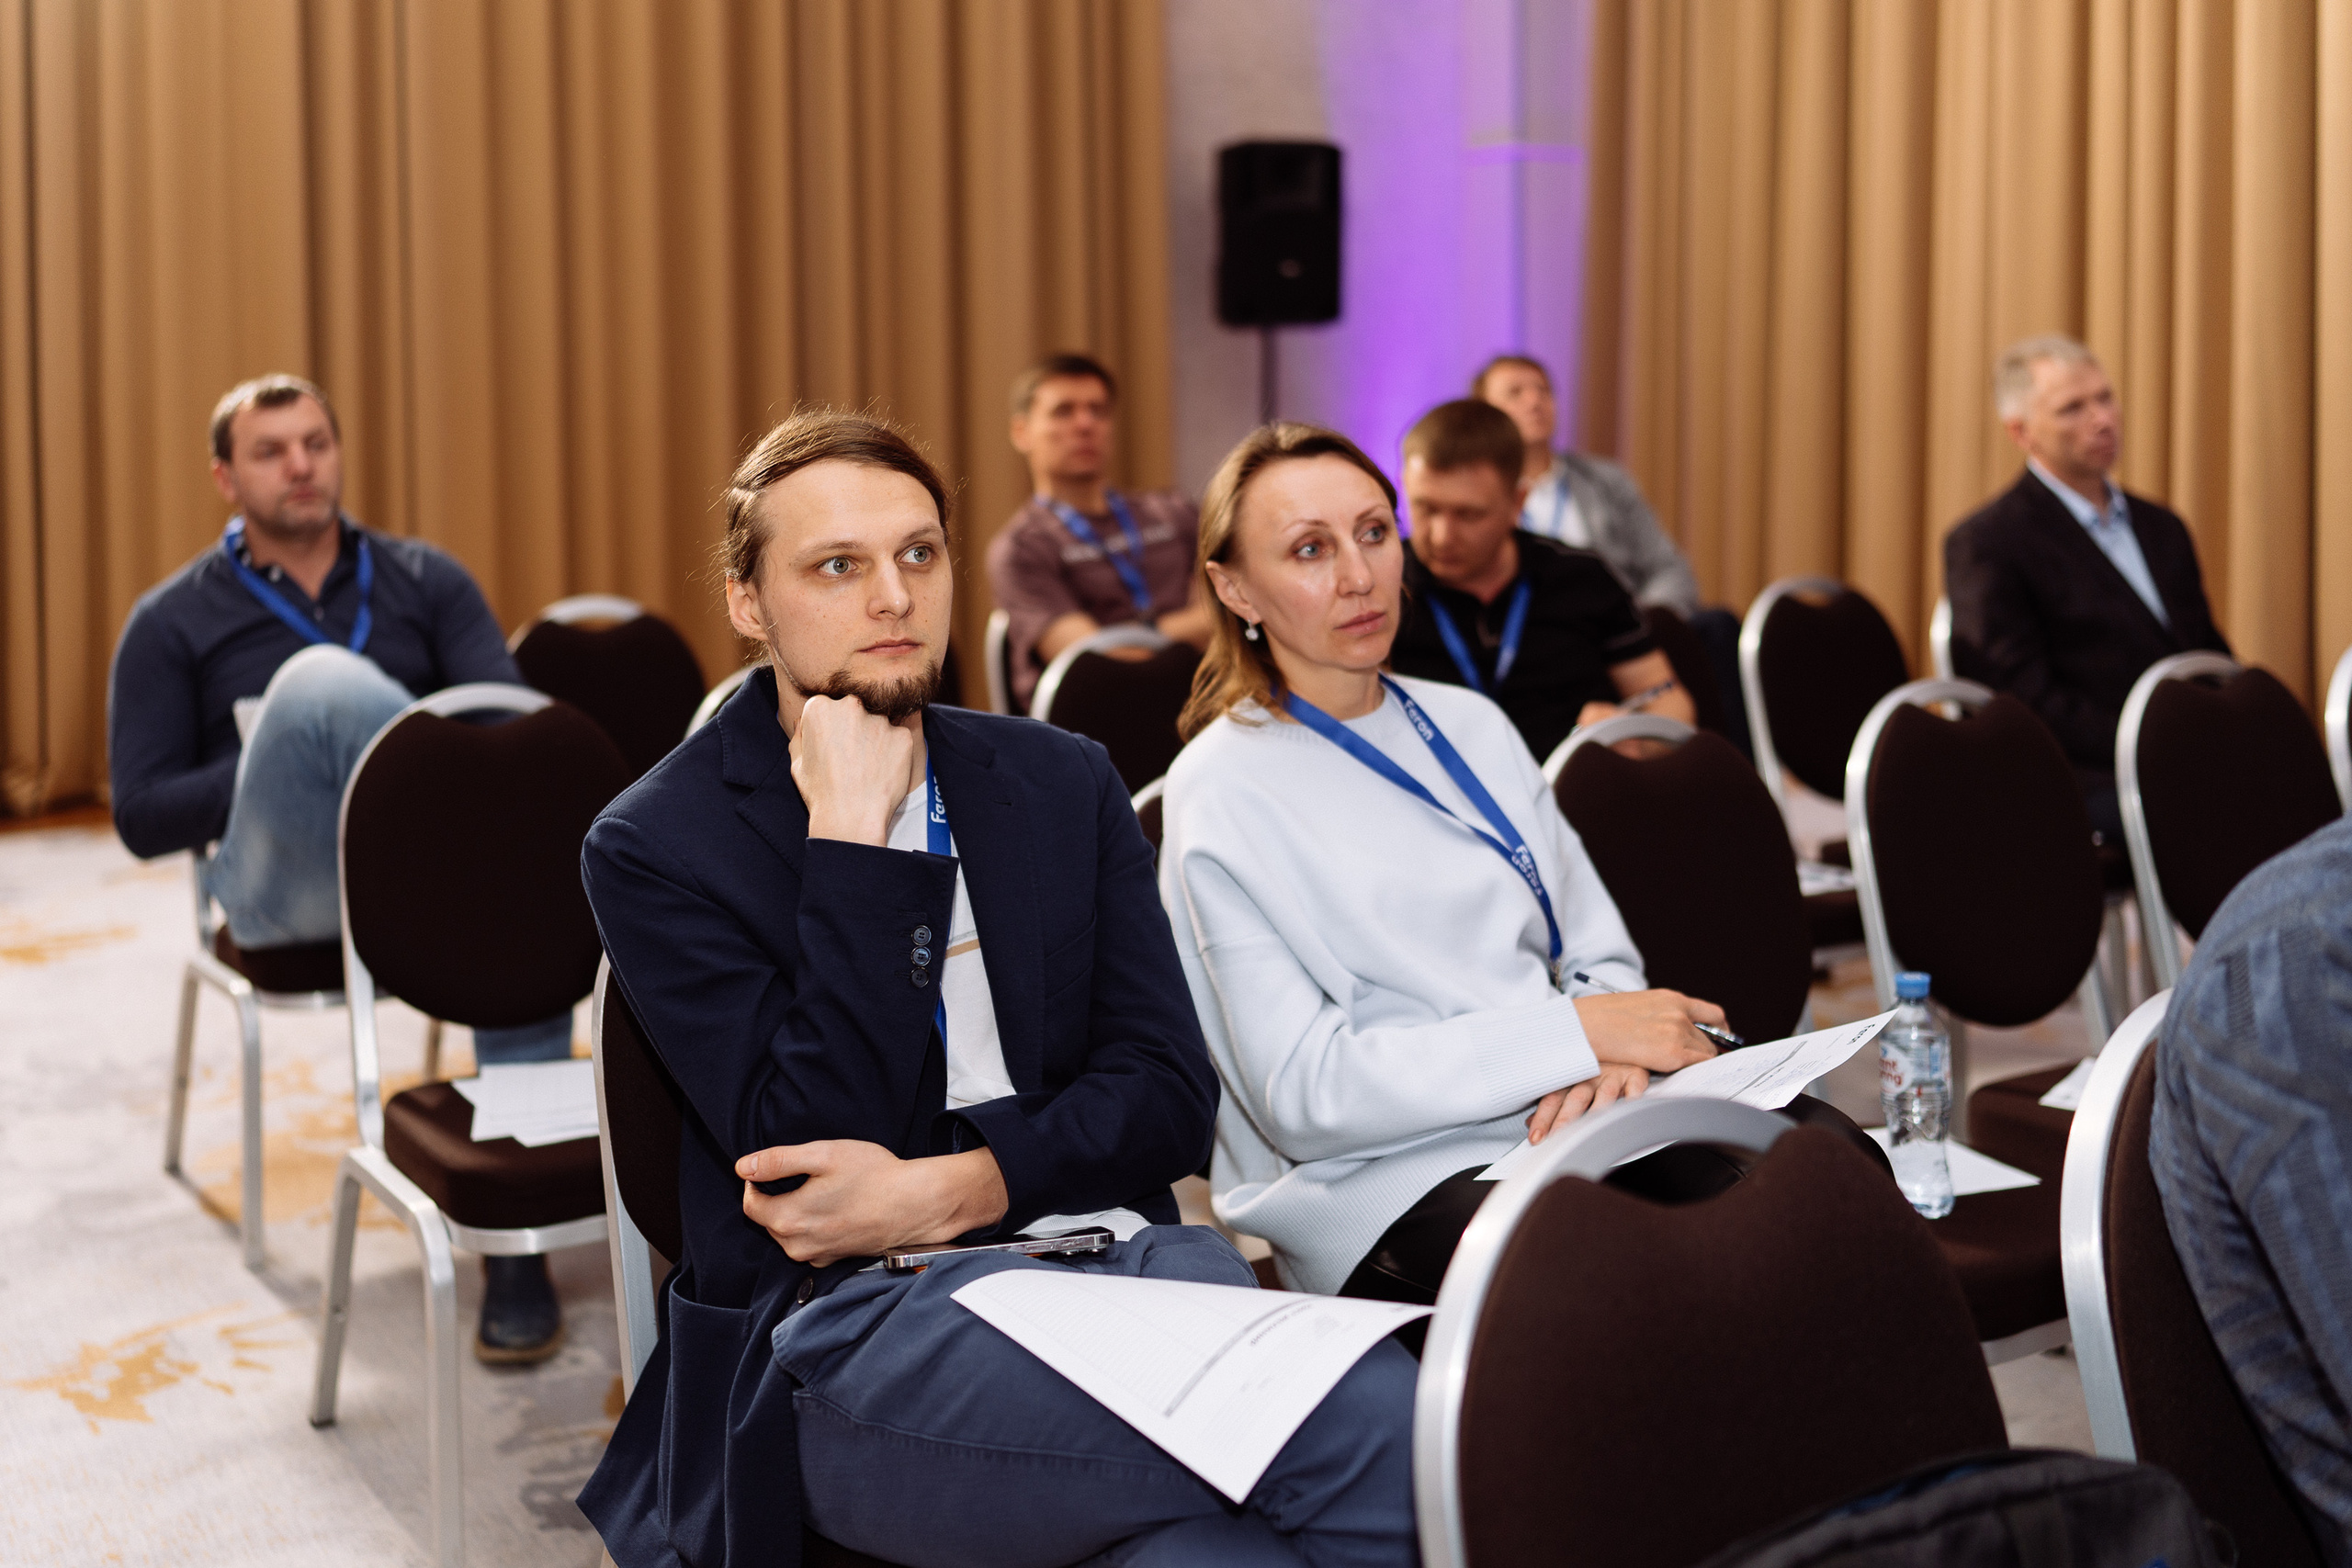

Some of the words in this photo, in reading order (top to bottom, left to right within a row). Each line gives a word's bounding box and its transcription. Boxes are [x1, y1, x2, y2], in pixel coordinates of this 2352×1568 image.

[1405, 699, 1434, 741] Feron
[931, 776, 946, 823] Fer
[1516, 845, 1541, 886] Fer
